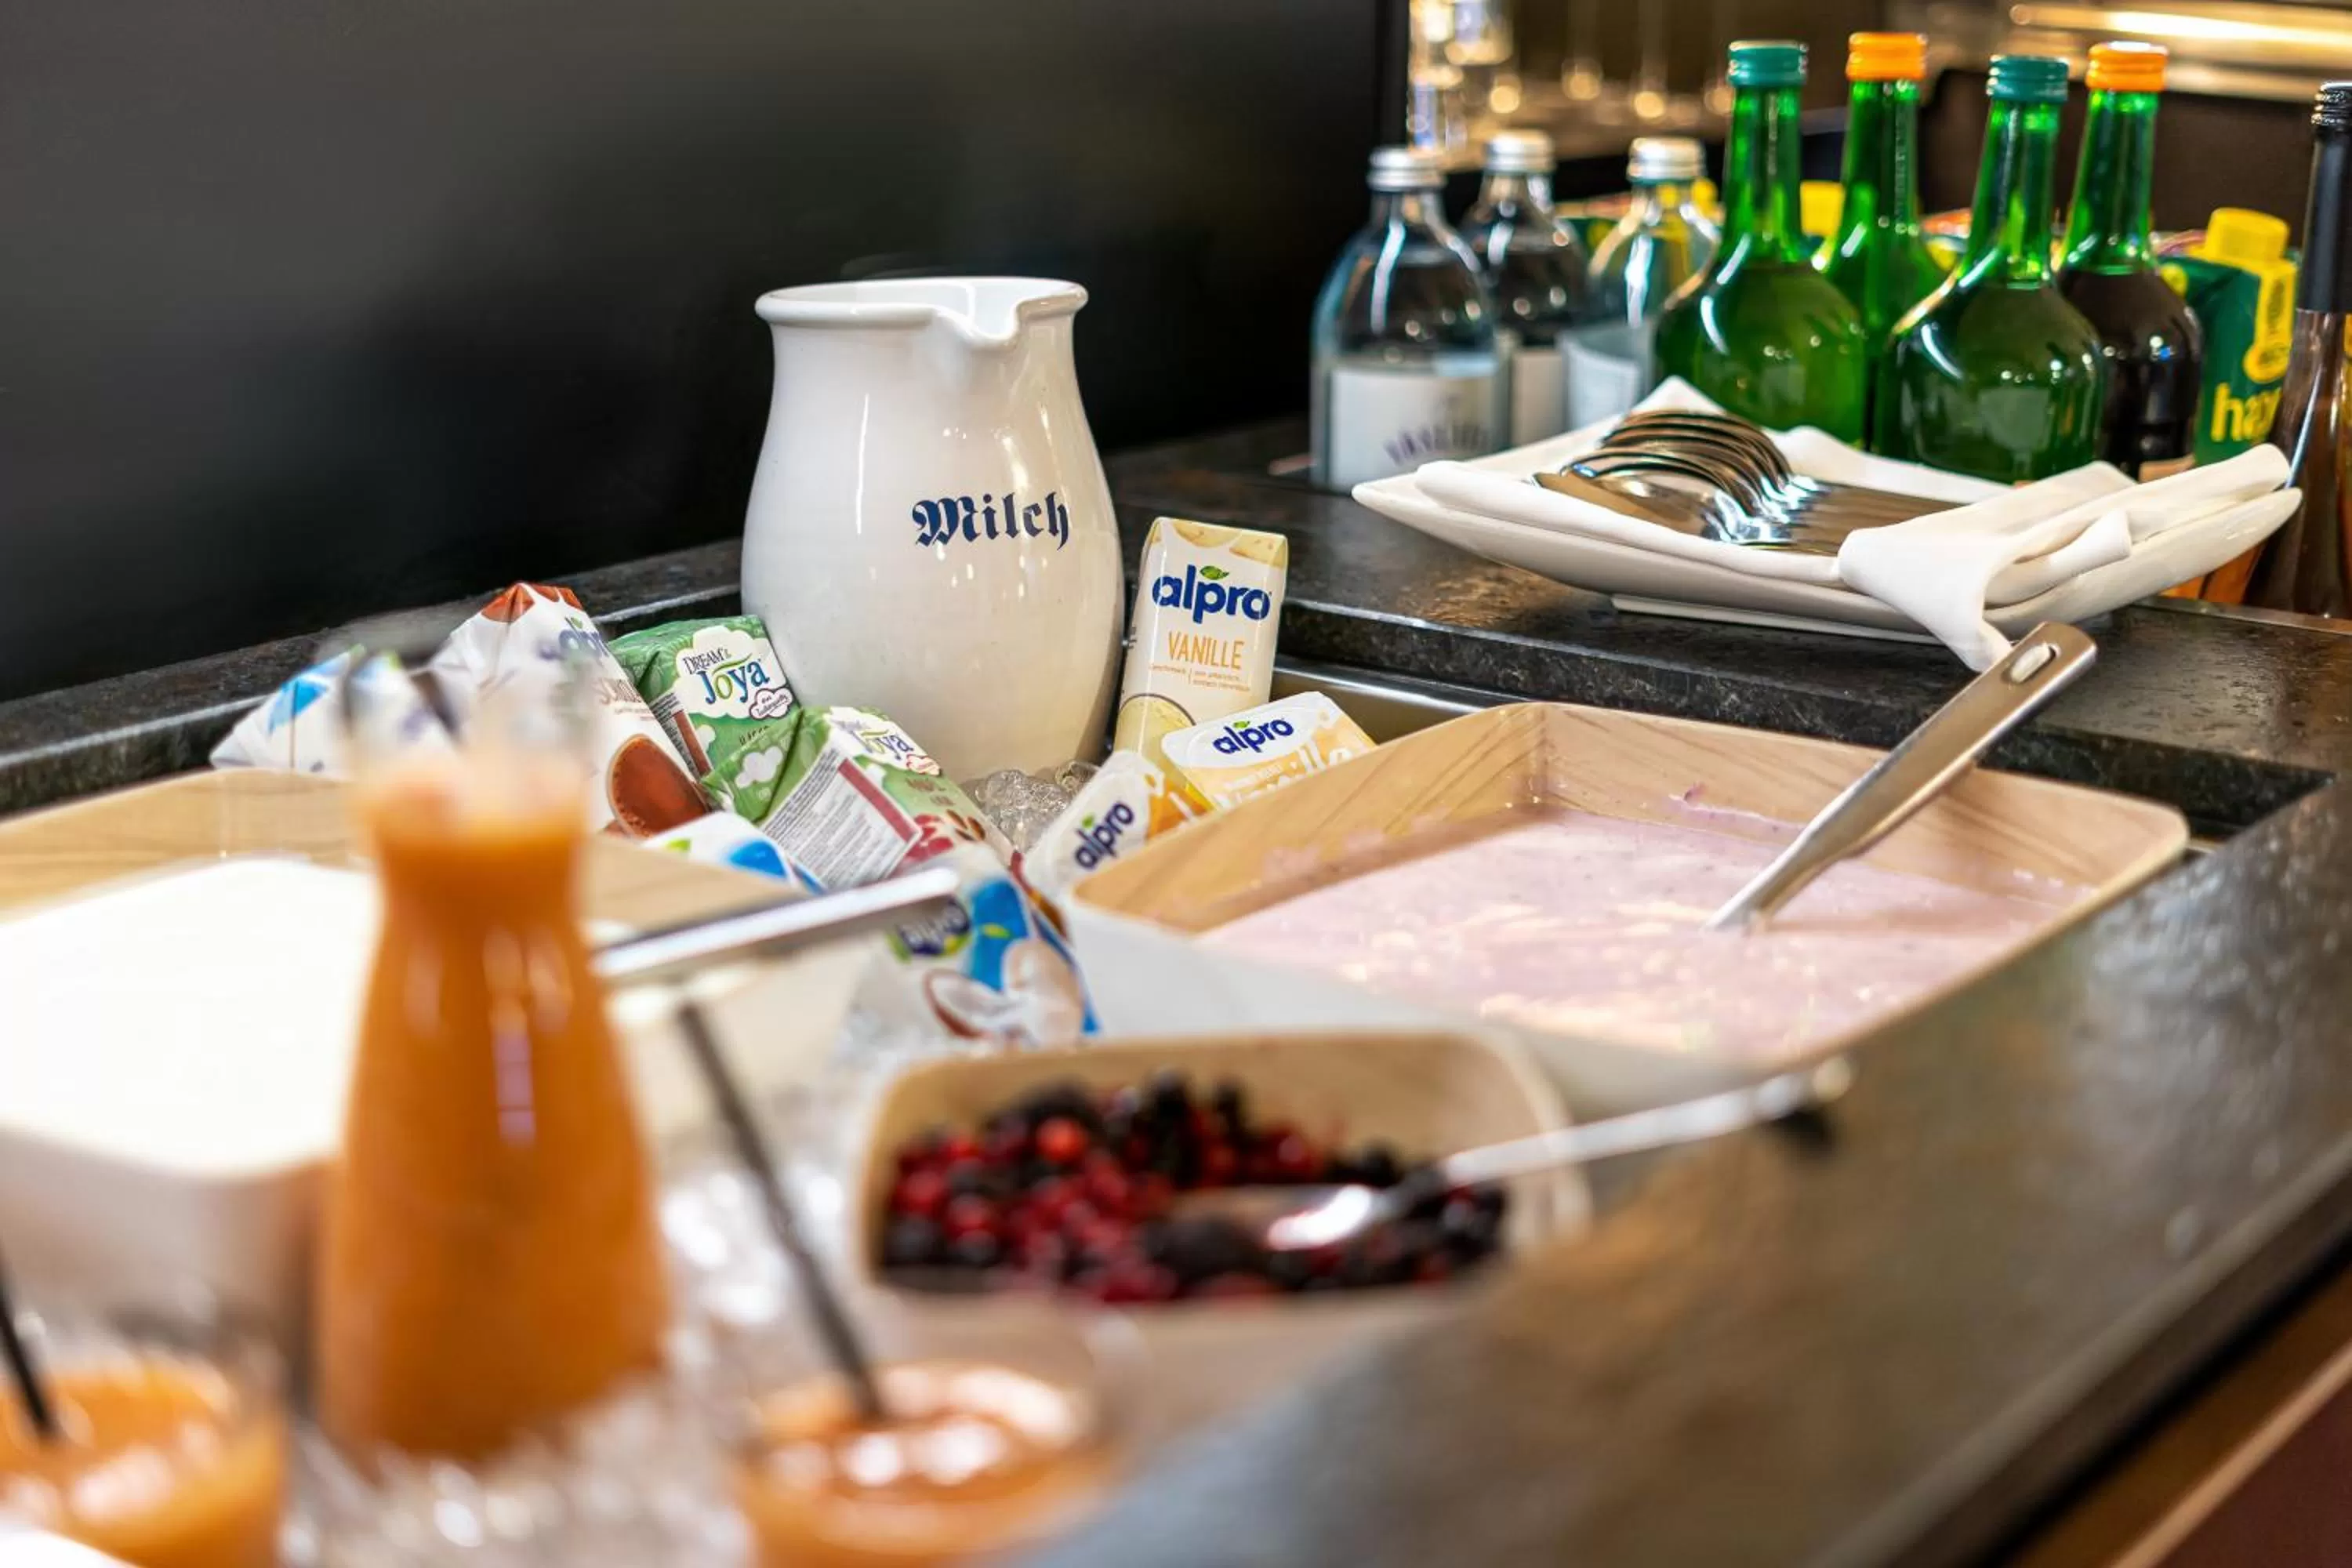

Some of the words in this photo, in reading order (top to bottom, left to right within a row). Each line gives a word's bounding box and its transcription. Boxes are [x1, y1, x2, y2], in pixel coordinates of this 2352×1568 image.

[912, 492, 1069, 550] Milch
[1152, 564, 1271, 624] alpro
[1168, 630, 1245, 670] VANILLE
[697, 661, 770, 705] Joya
[1213, 719, 1294, 753] alpro
[1075, 802, 1134, 869] alpro
